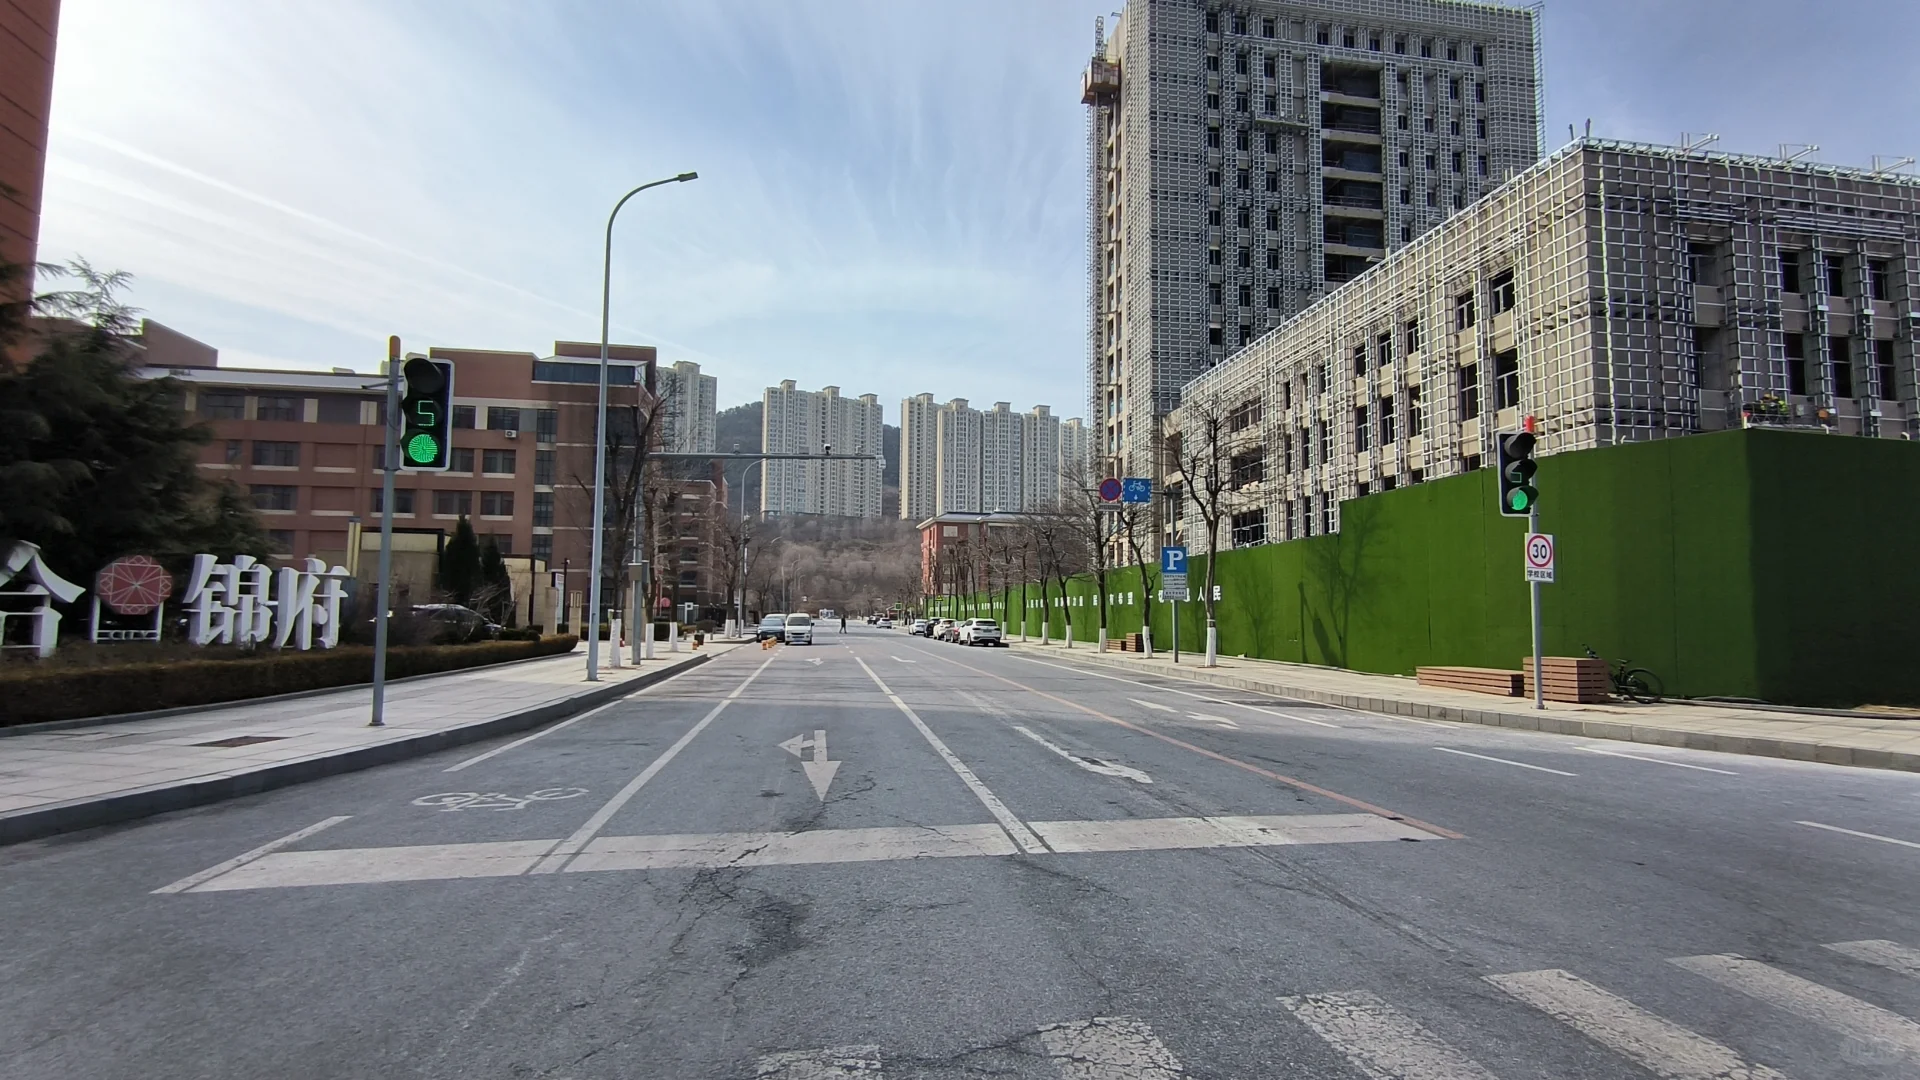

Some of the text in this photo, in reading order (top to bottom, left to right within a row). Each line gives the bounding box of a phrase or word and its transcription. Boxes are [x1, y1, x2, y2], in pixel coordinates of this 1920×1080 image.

[417, 400, 434, 426] 5
[1166, 550, 1184, 570] P
[1532, 544, 1547, 559] 30
[1527, 569, 1552, 579] 学校区域
[182, 553, 350, 651] 锦府
